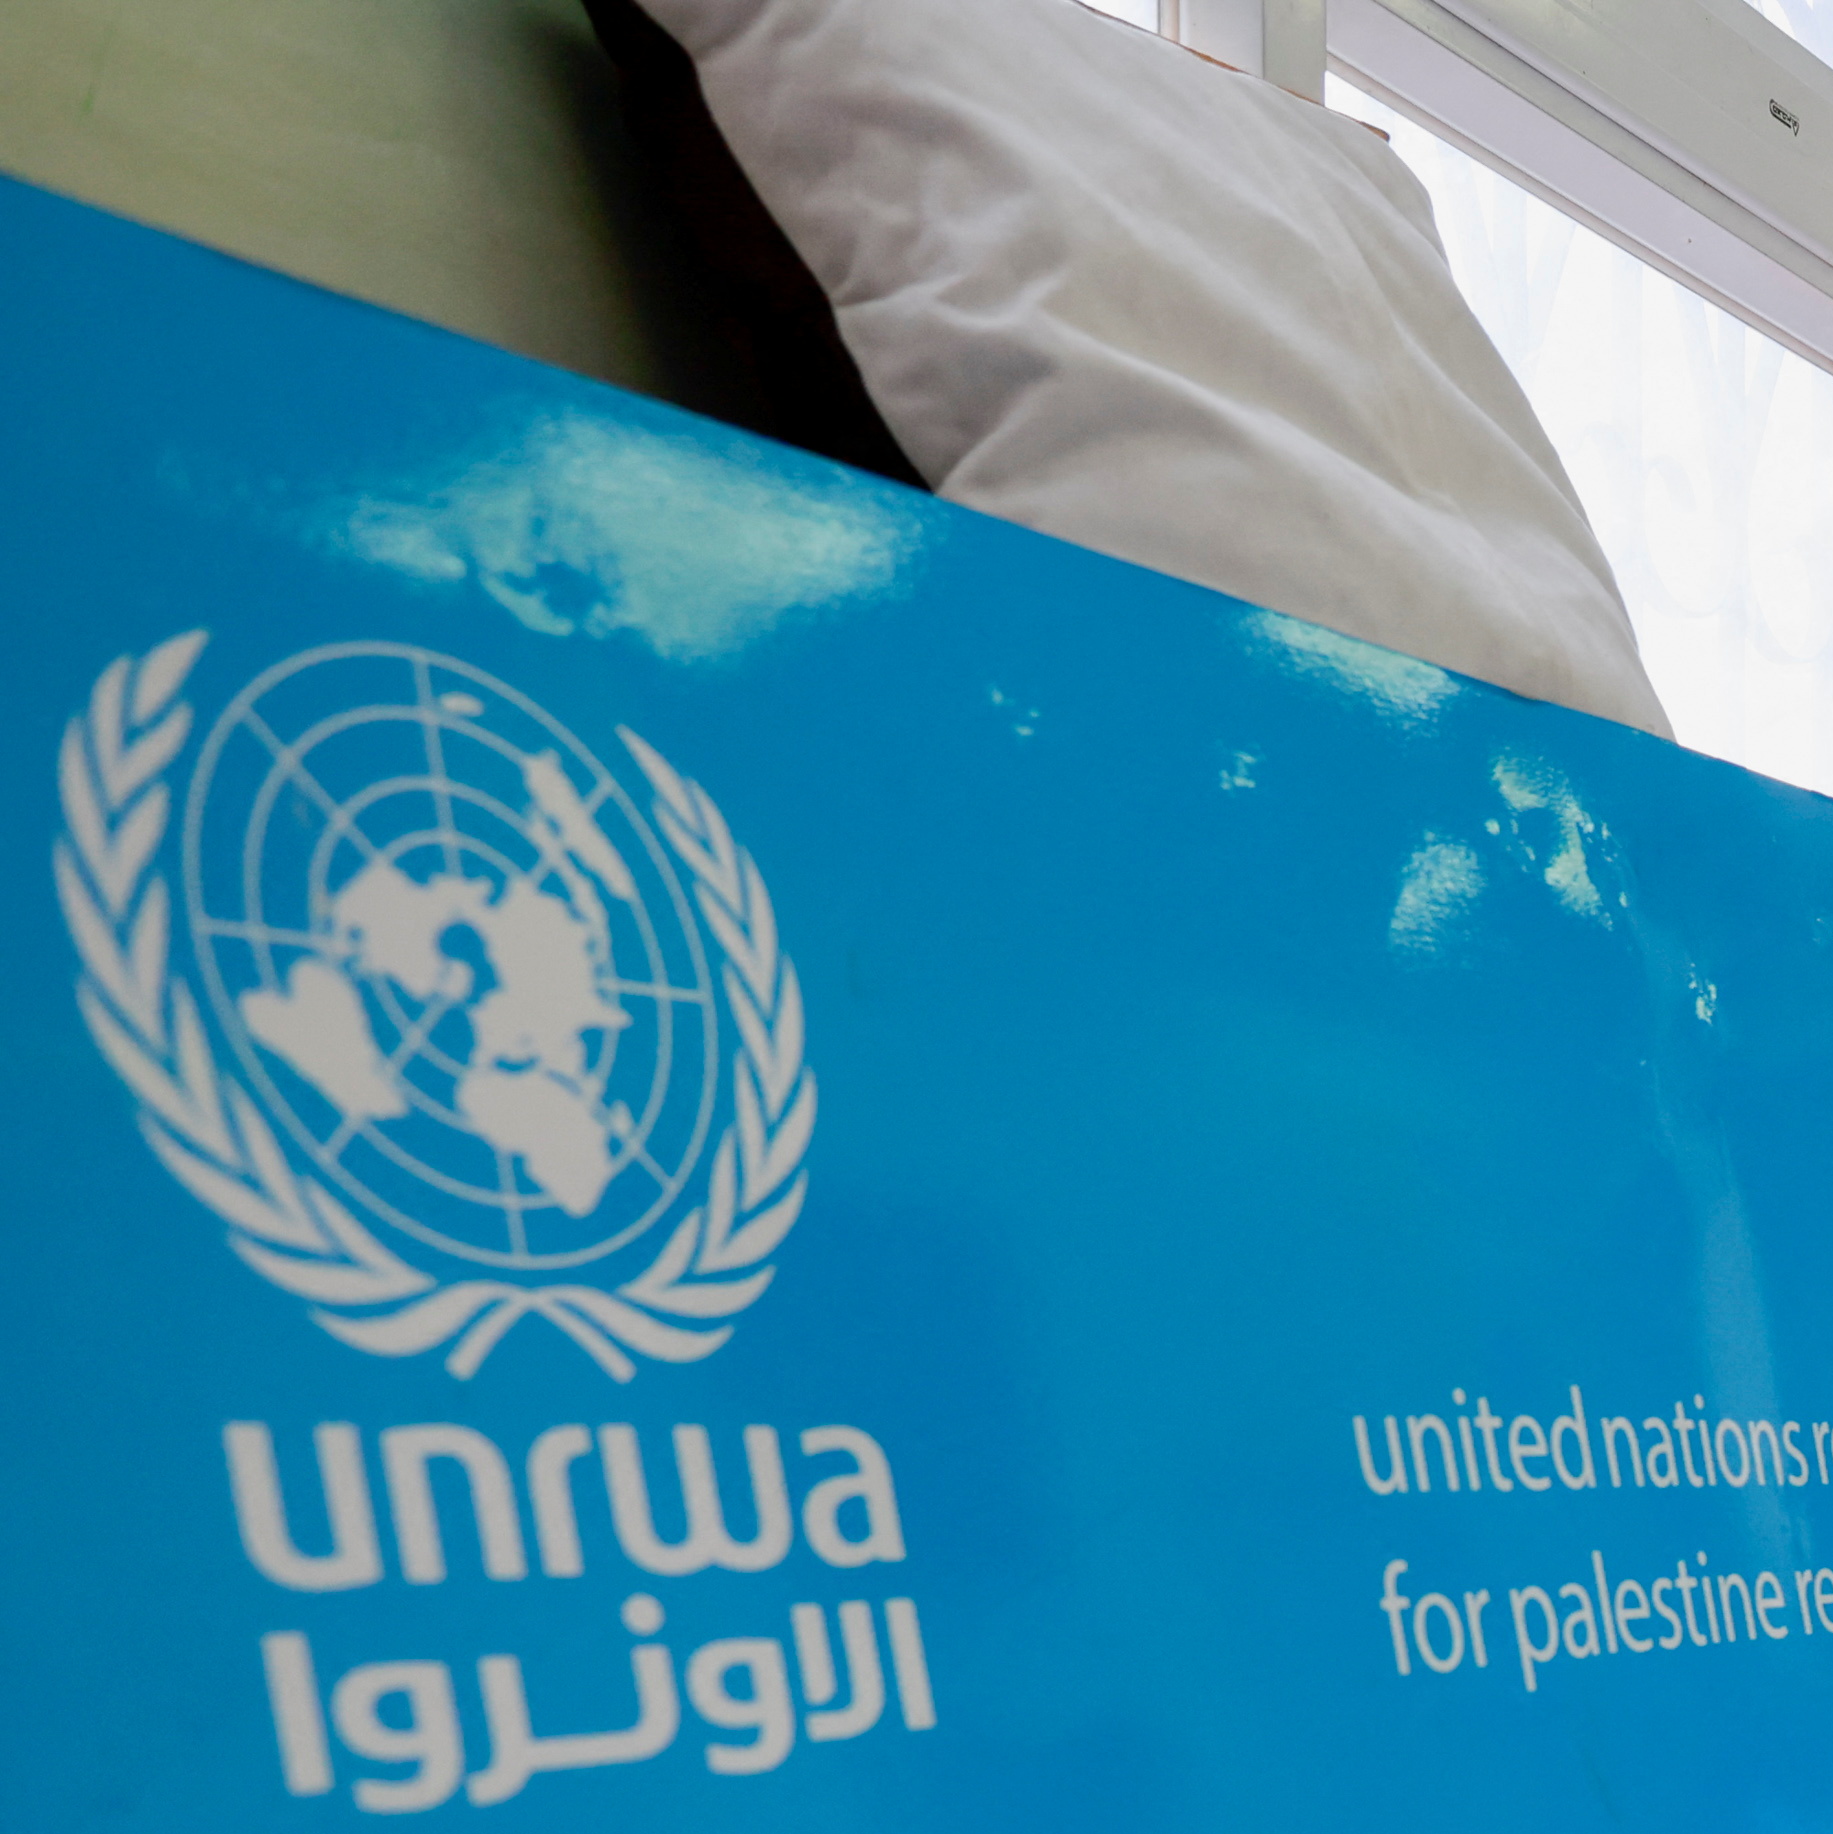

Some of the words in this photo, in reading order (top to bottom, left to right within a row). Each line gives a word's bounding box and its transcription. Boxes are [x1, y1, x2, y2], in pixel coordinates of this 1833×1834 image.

[223, 1420, 908, 1593] unrwa
[1352, 1384, 1597, 1495] united
[1600, 1393, 1810, 1489] nations
[1379, 1558, 1491, 1676] for
[1508, 1549, 1789, 1693] palestine
[259, 1592, 938, 1815] الاونروا
